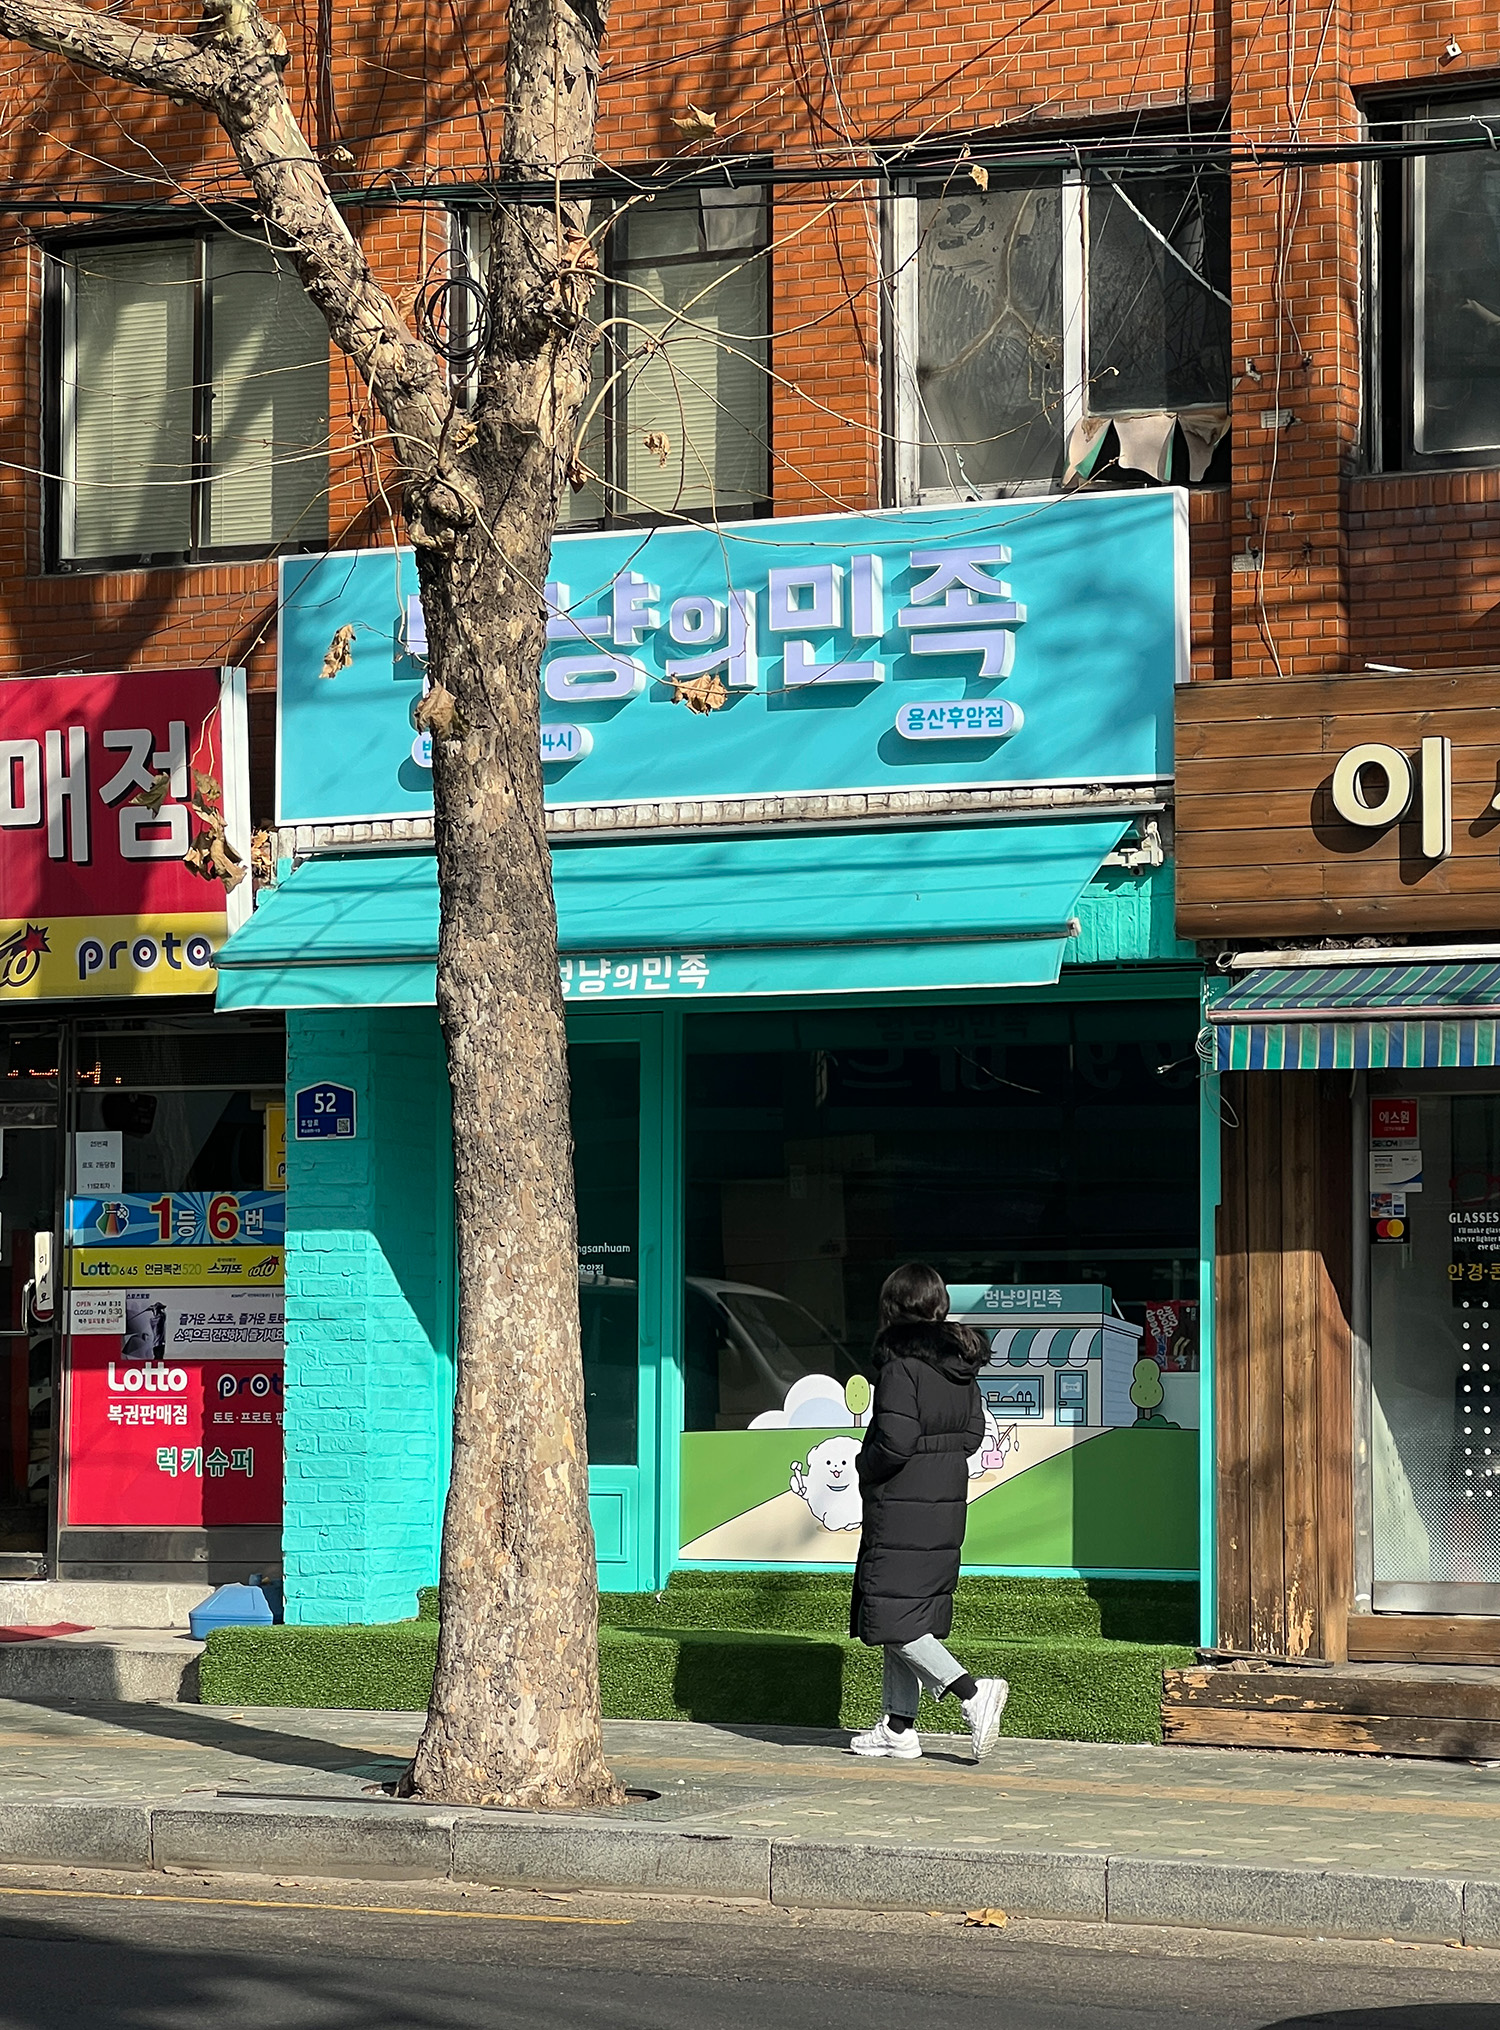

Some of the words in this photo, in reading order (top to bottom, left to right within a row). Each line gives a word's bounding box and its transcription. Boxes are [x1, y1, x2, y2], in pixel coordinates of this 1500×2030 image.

[408, 545, 1027, 703] 냥의민족
[906, 705, 1004, 731] 용산후암점
[0, 720, 190, 863] 매점
[1332, 736, 1500, 860] 이
[77, 933, 212, 980] proto
[314, 1092, 337, 1113] 52
[1379, 1110, 1410, 1124] 에스원
[150, 1196, 197, 1241] 1등
[207, 1194, 264, 1242] 6번
[1448, 1211, 1500, 1223] GLASSES
[80, 1261, 120, 1276] Lotto
[983, 1289, 1063, 1308] 멍냥의민족
[179, 1313, 206, 1326] 즐거운
[239, 1312, 266, 1326] 즐거운
[174, 1329, 211, 1342] 소액으로
[211, 1328, 248, 1342] 건전하게
[107, 1361, 188, 1392] Lotto
[107, 1404, 188, 1426] 복권판매점
[156, 1446, 254, 1477] 럭키슈퍼
